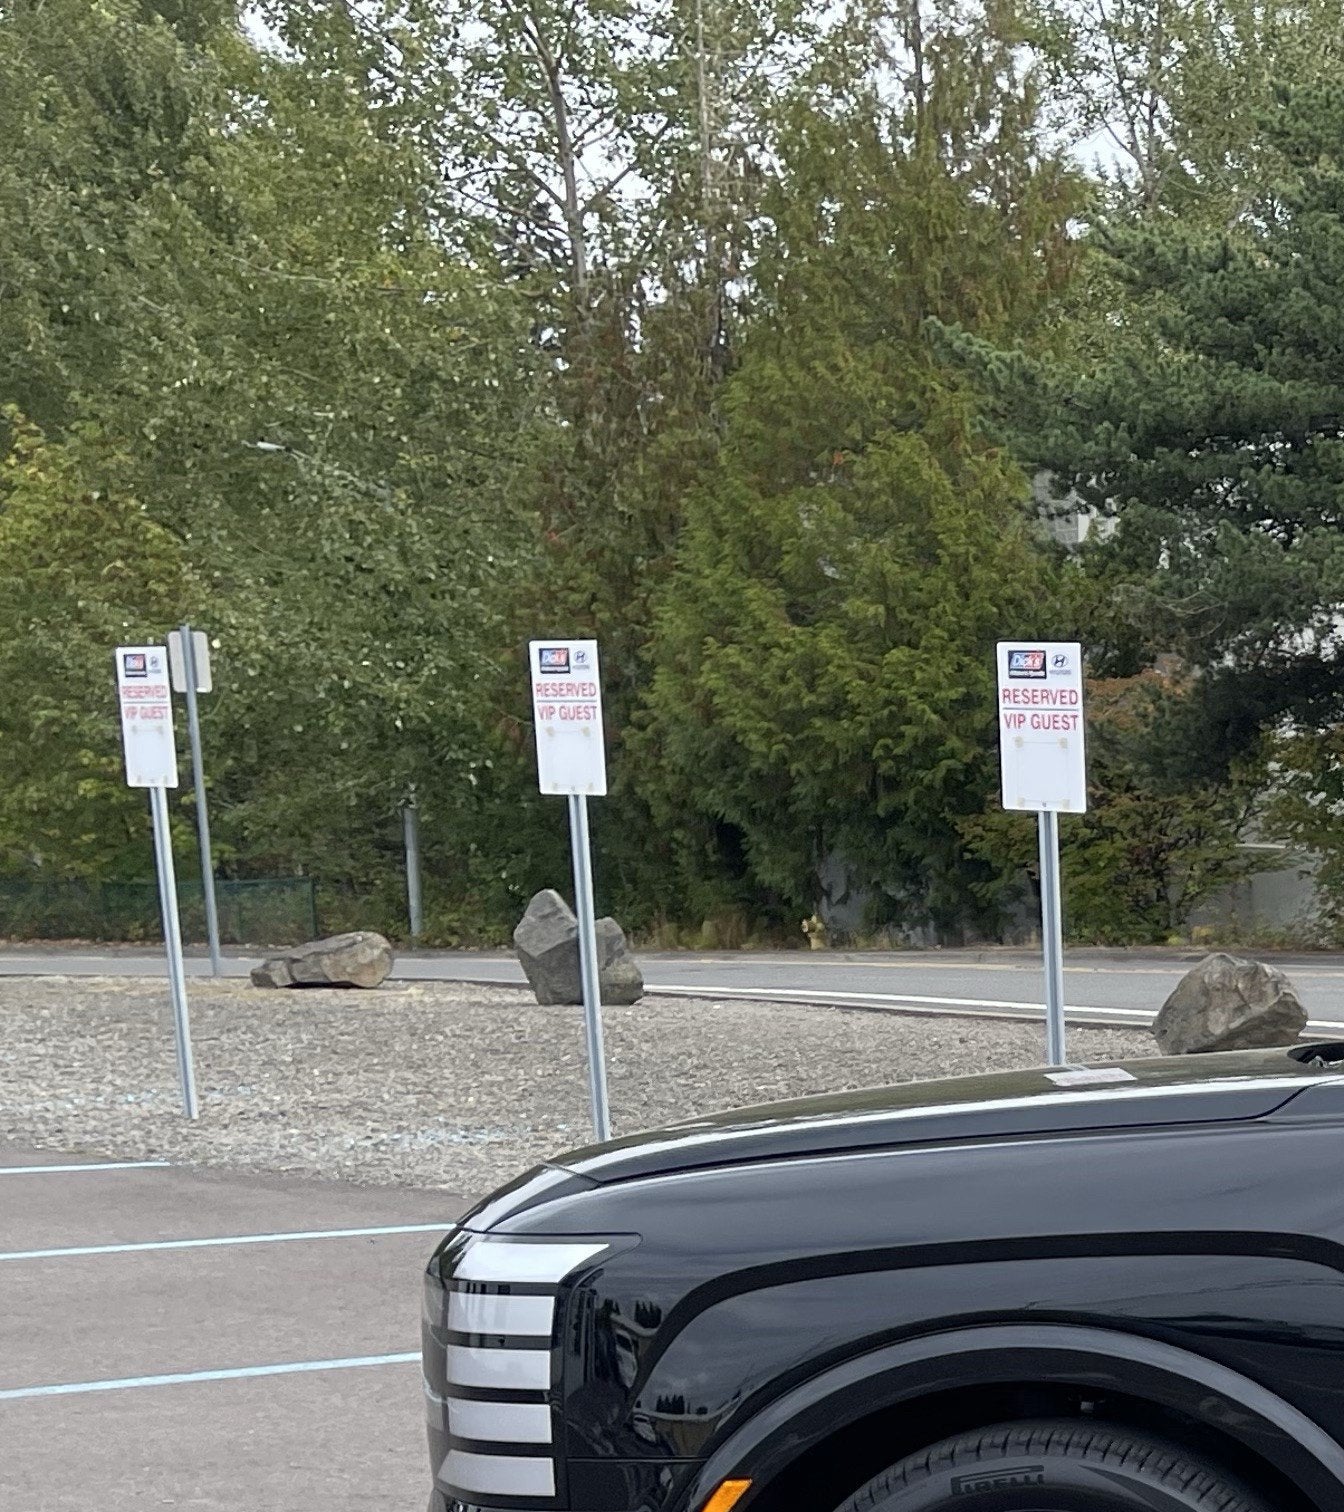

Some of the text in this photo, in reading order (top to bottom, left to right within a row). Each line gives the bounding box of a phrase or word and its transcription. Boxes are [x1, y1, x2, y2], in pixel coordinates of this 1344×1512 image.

[536, 682, 597, 697] RESERVED
[1002, 688, 1078, 705] RESERVED
[537, 705, 597, 720] VIP GUEST
[1003, 713, 1078, 730] VIP GUEST
[950, 1464, 1044, 1495] PIRELLI
